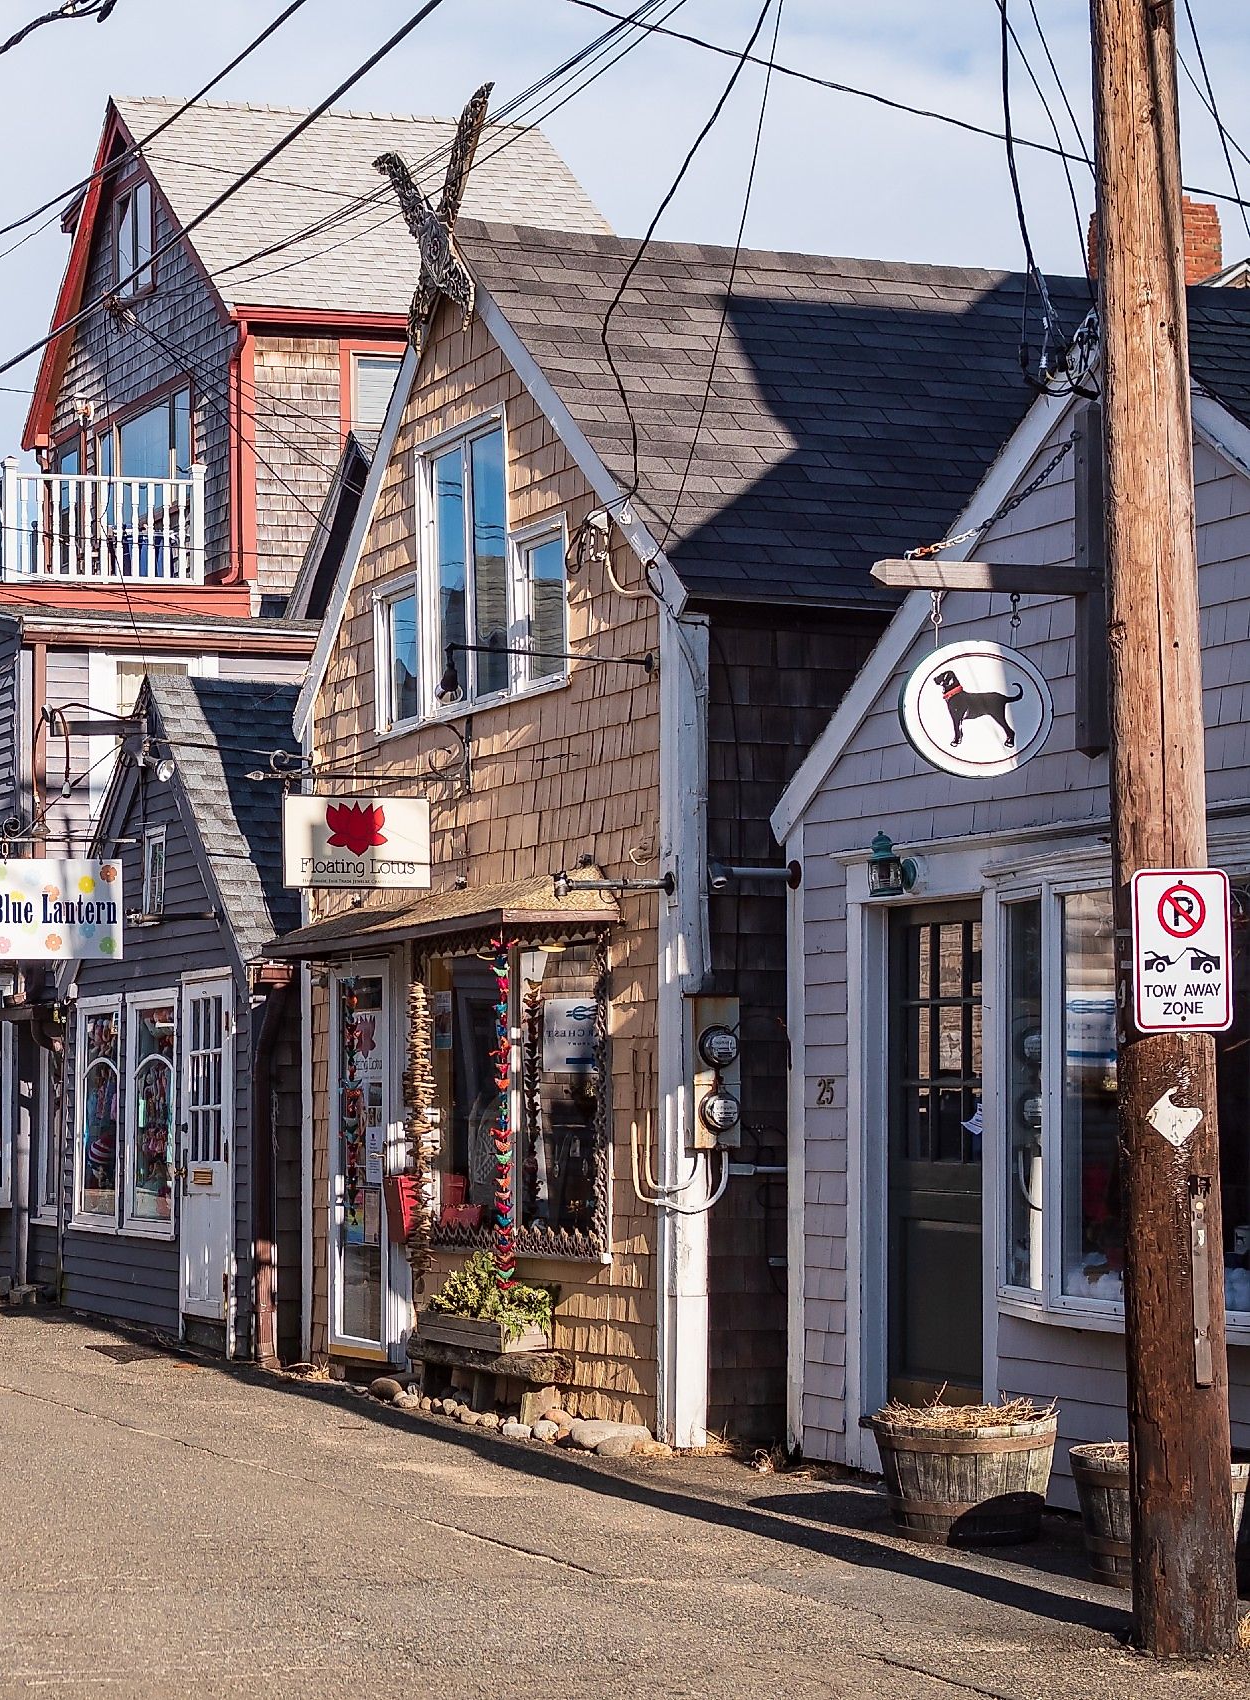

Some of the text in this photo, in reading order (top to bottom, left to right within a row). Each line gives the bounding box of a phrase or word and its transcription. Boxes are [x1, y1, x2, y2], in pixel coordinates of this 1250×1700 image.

[300, 857, 416, 878] Floating Lotus
[41, 893, 118, 925] Lantern
[1143, 982, 1222, 998] TOW AWAY
[1162, 1001, 1204, 1016] ZONE
[815, 1078, 836, 1105] 25
